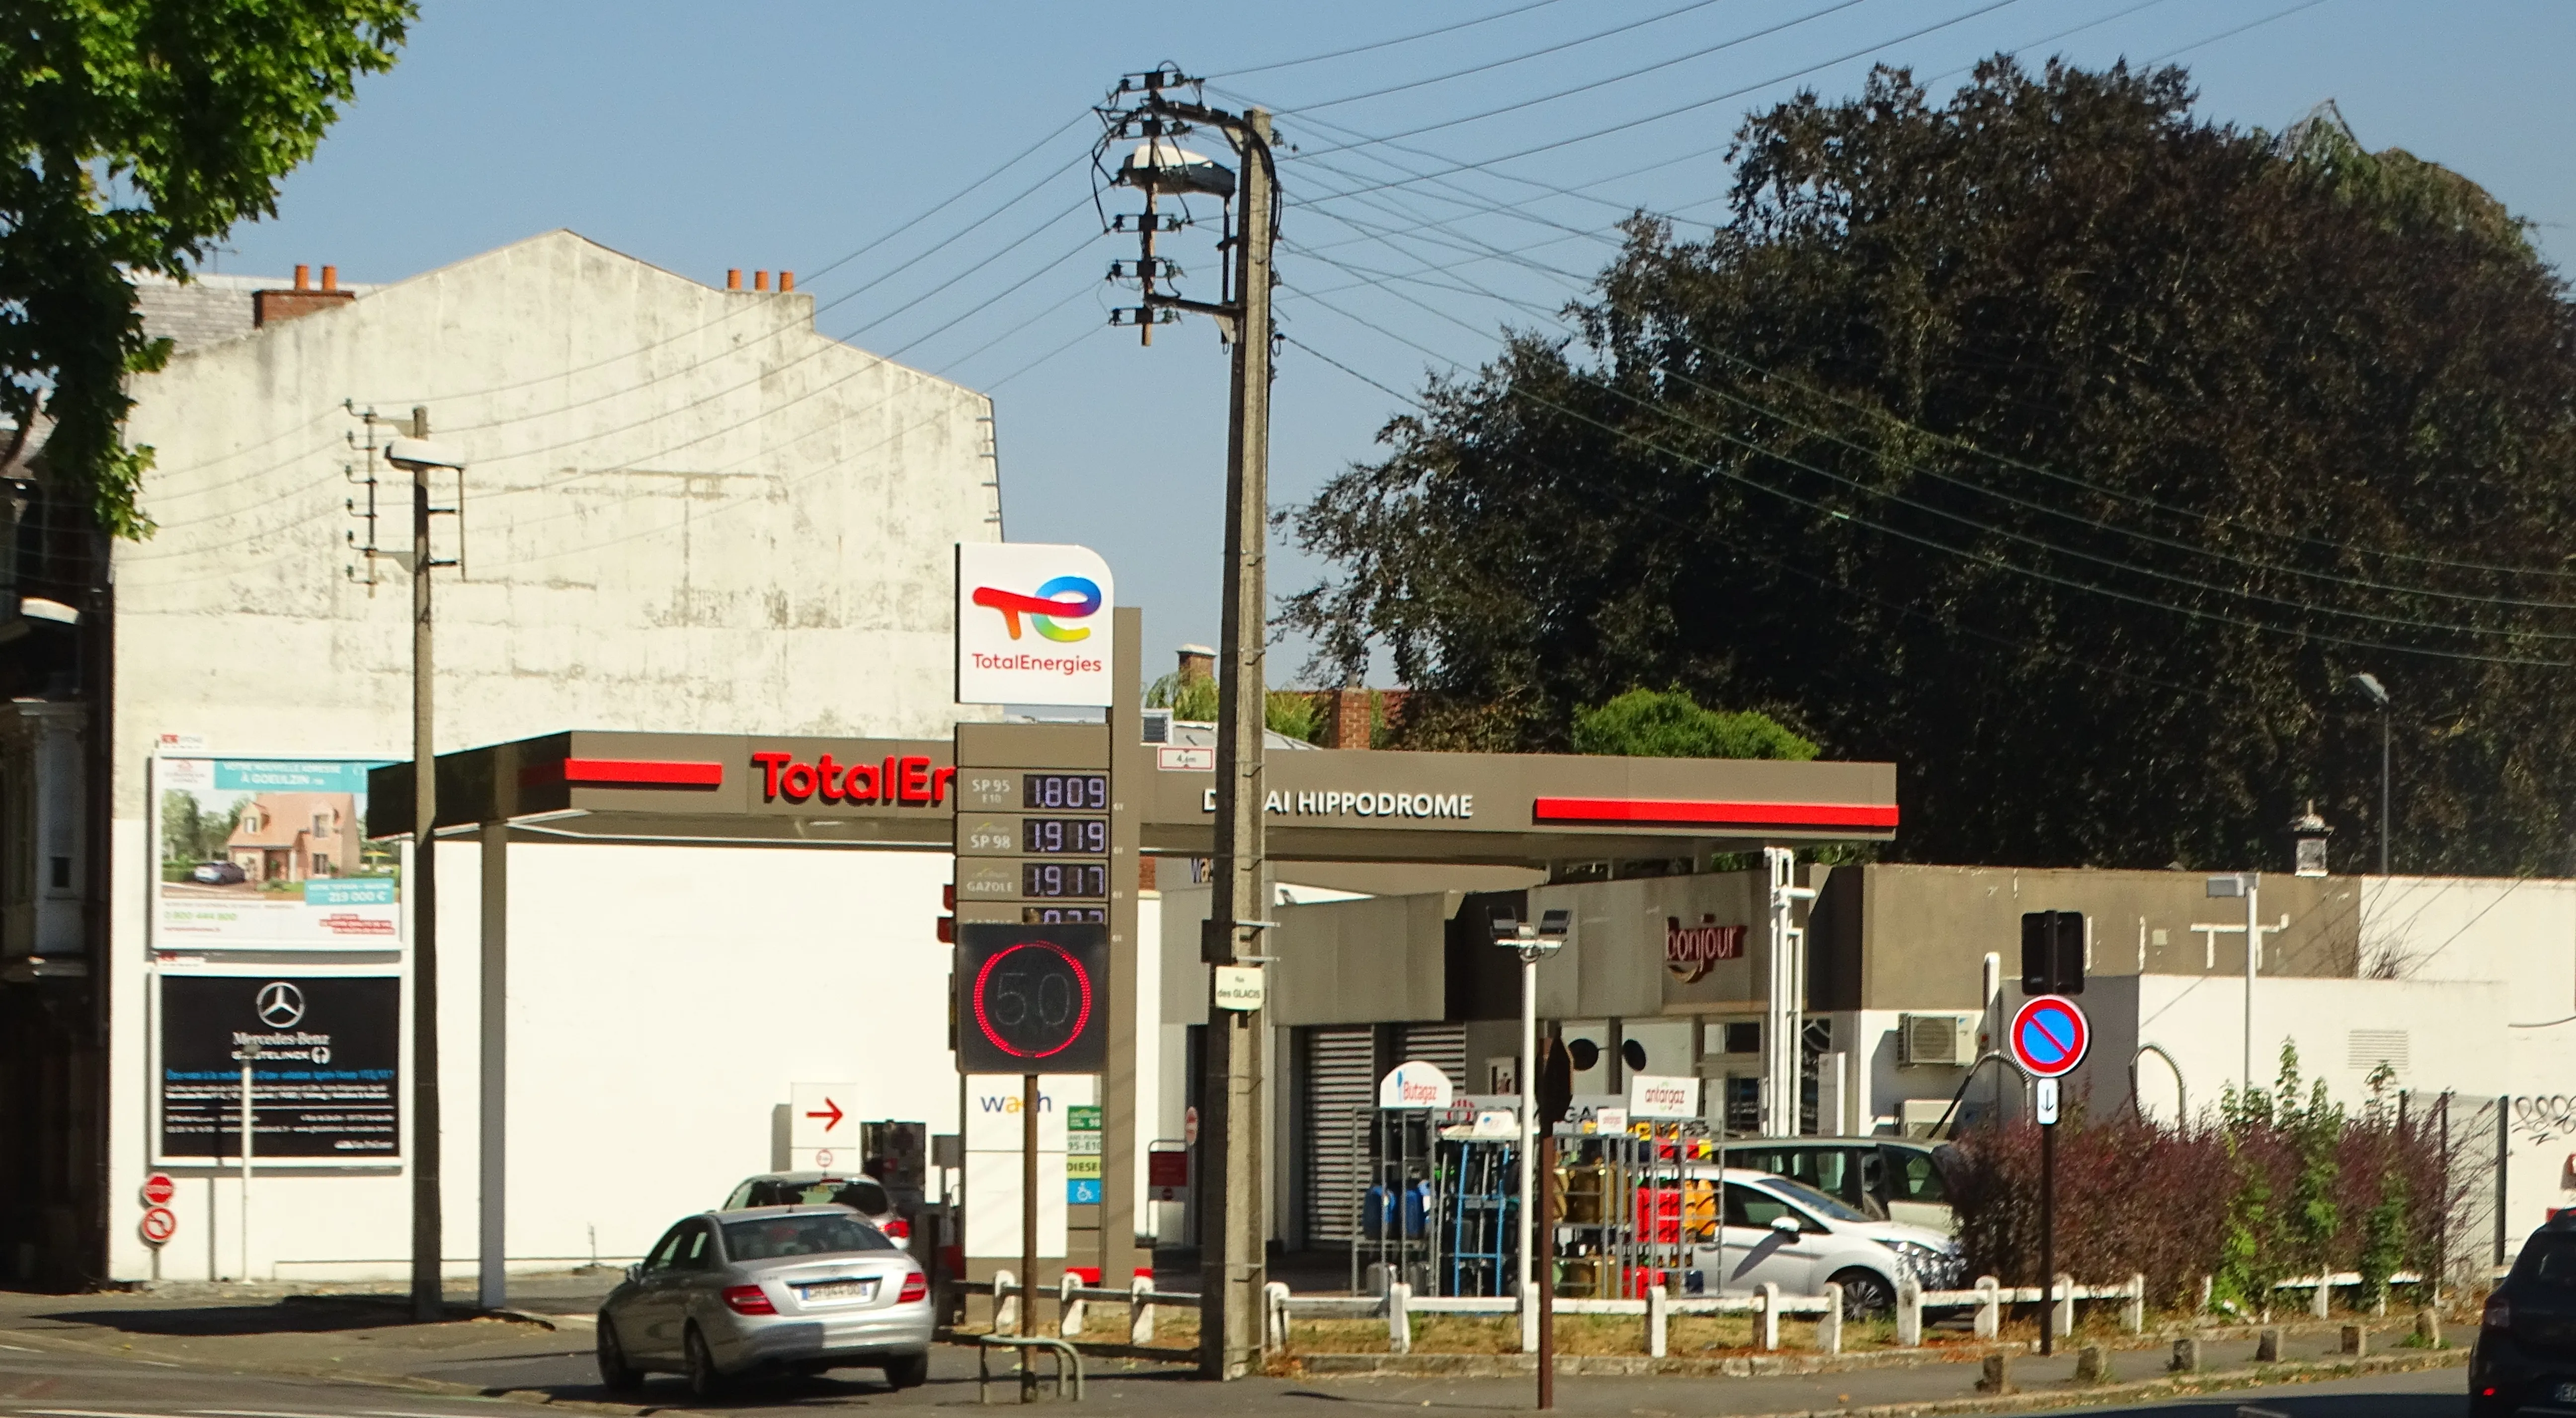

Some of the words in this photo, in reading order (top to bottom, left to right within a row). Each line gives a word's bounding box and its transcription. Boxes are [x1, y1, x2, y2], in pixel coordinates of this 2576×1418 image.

[972, 653, 1102, 676] TotalEnergies
[971, 779, 990, 792] SP
[993, 779, 1011, 793] 95
[1204, 788, 1290, 814] DAI
[1297, 790, 1473, 818] HIPPODROME
[970, 835, 990, 850] SP
[992, 835, 1012, 850] 98
[966, 882, 1014, 893] GAZOLE
[1666, 914, 1739, 972] bonjour
[995, 972, 1070, 1026] 50
[980, 1091, 1052, 1113] wah
[1403, 1081, 1437, 1107] Butagaz
[1067, 1162, 1101, 1173] DIESE
